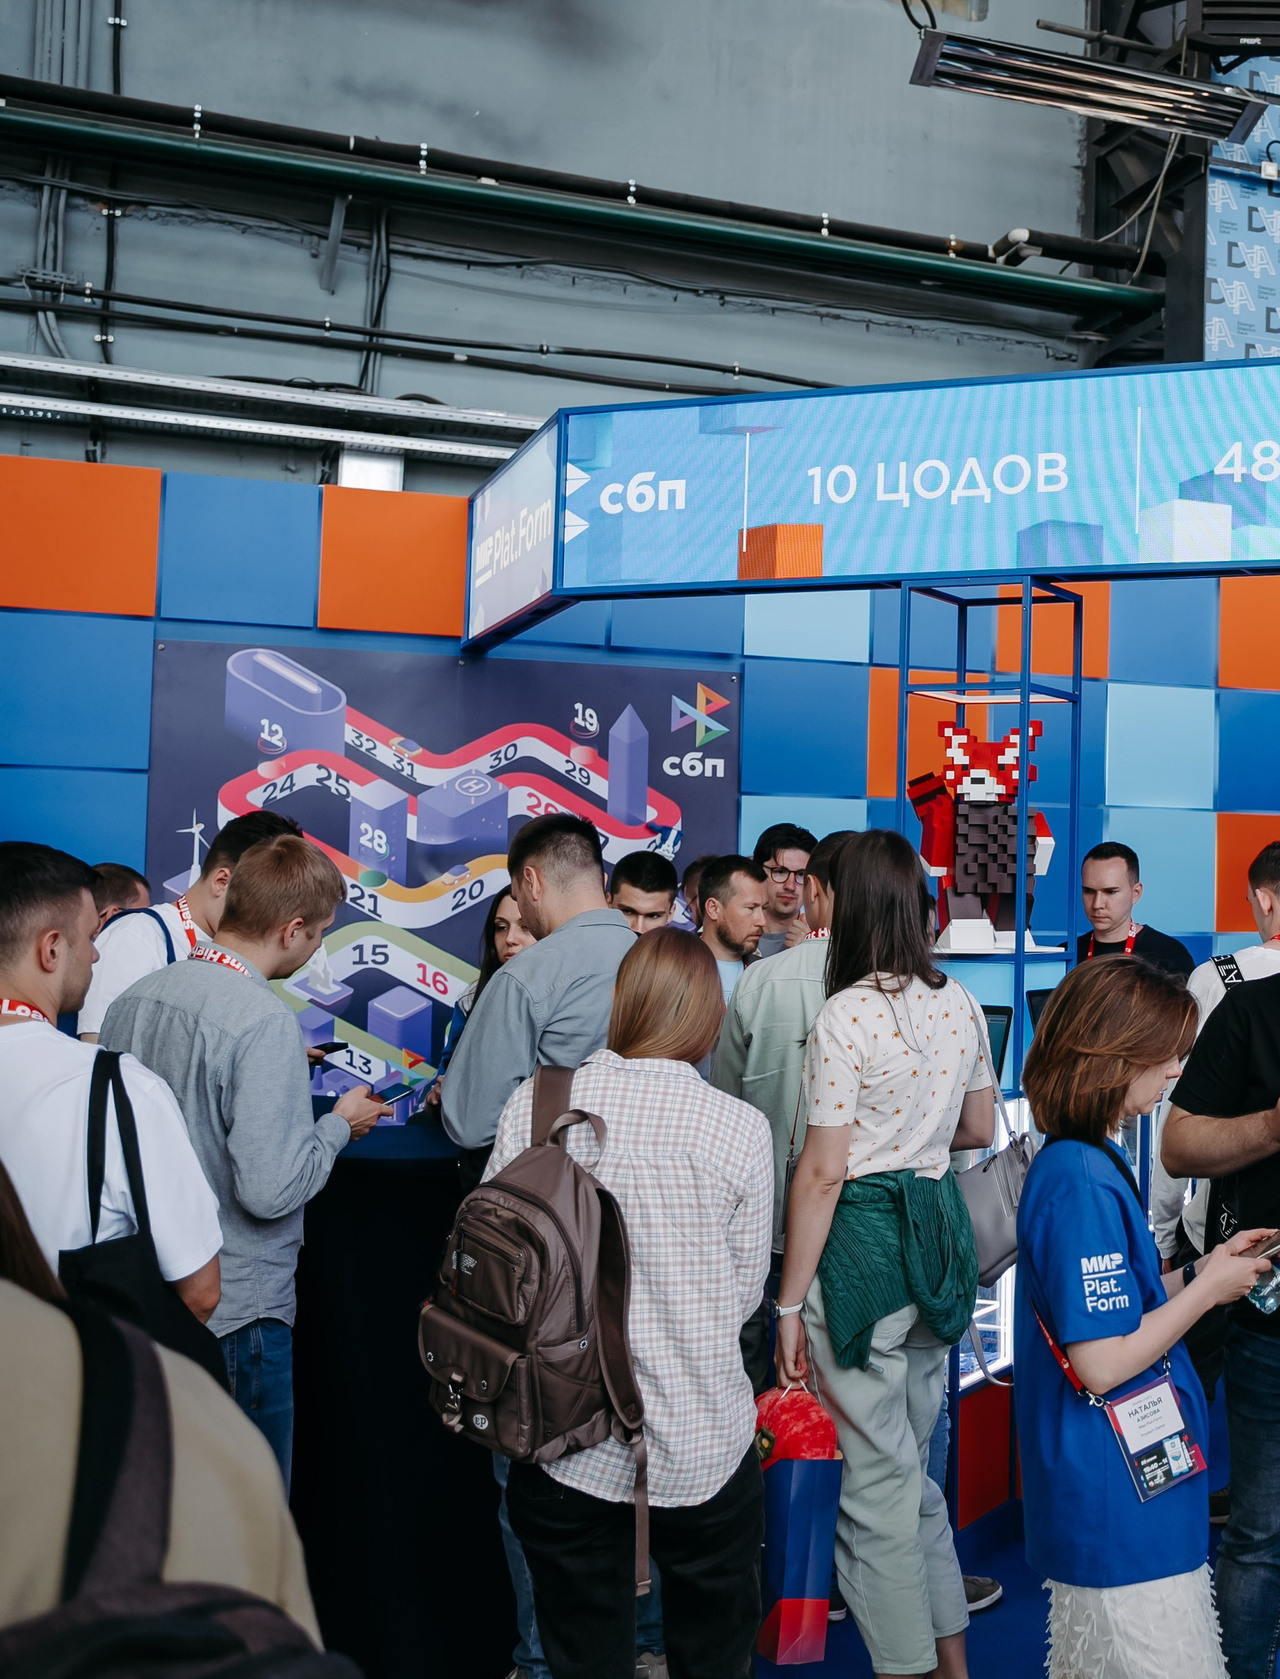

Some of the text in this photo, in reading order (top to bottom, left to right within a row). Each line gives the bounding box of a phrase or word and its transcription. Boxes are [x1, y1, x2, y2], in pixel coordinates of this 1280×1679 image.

[600, 471, 687, 515] сбп
[807, 453, 1068, 508] 10 ЦОДОВ
[493, 498, 551, 575] Plat.Form
[574, 702, 598, 732] 19
[260, 719, 284, 747] 12
[350, 729, 377, 758] 32
[392, 753, 418, 781] 31
[489, 743, 518, 769] 30
[662, 752, 725, 778] сбп
[316, 764, 351, 801] 25
[564, 759, 591, 786] 29
[262, 773, 296, 806] 24
[359, 822, 388, 854] 28
[349, 883, 382, 918] 21
[451, 879, 485, 912] 20
[352, 944, 390, 965] 15
[416, 963, 449, 996] 16
[345, 1050, 372, 1075] 13
[1083, 1278, 1122, 1296] Plat.
[1085, 1294, 1129, 1313] Form
[1128, 1396, 1163, 1419] НАТАЛЬЯ
